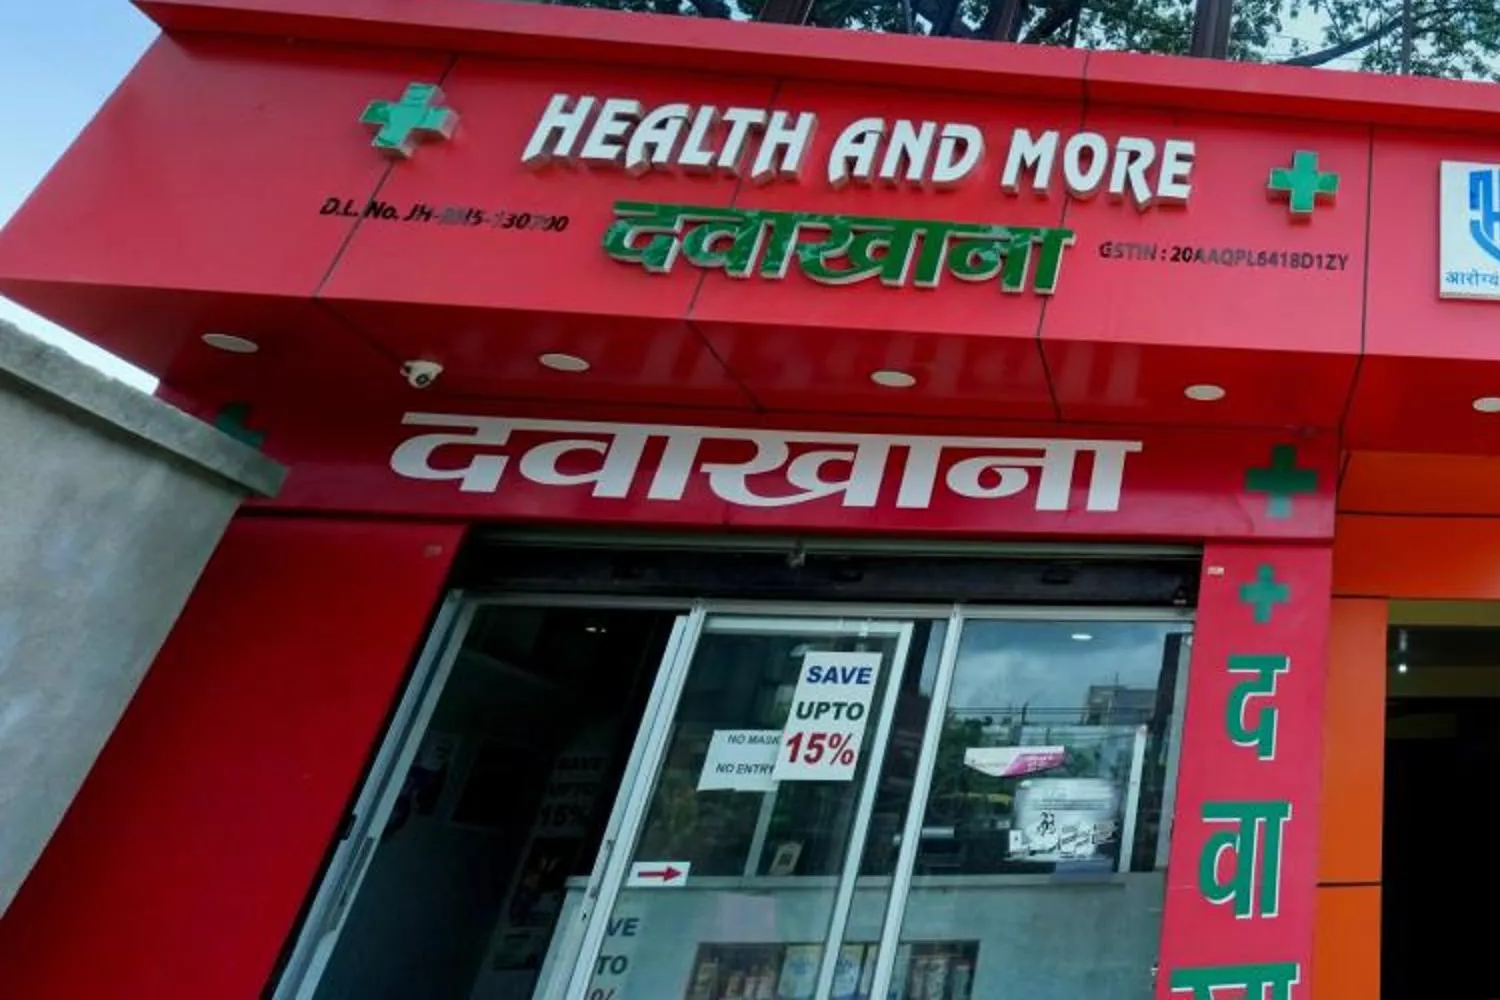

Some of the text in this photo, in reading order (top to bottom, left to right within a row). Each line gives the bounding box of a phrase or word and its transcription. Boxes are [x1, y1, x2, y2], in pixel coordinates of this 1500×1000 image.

[521, 93, 1196, 212] HEALTH AND MORE
[601, 200, 1077, 296] दवाखाना
[1099, 240, 1157, 263] GSTIN
[389, 411, 1143, 512] दवाखाना
[806, 666, 873, 685] SAVE
[796, 701, 865, 721] UPTO
[727, 733, 780, 746] NO MASK
[786, 732, 855, 766] 15%
[716, 763, 734, 774] NO
[606, 917, 640, 937] VE
[597, 954, 629, 976] TO
